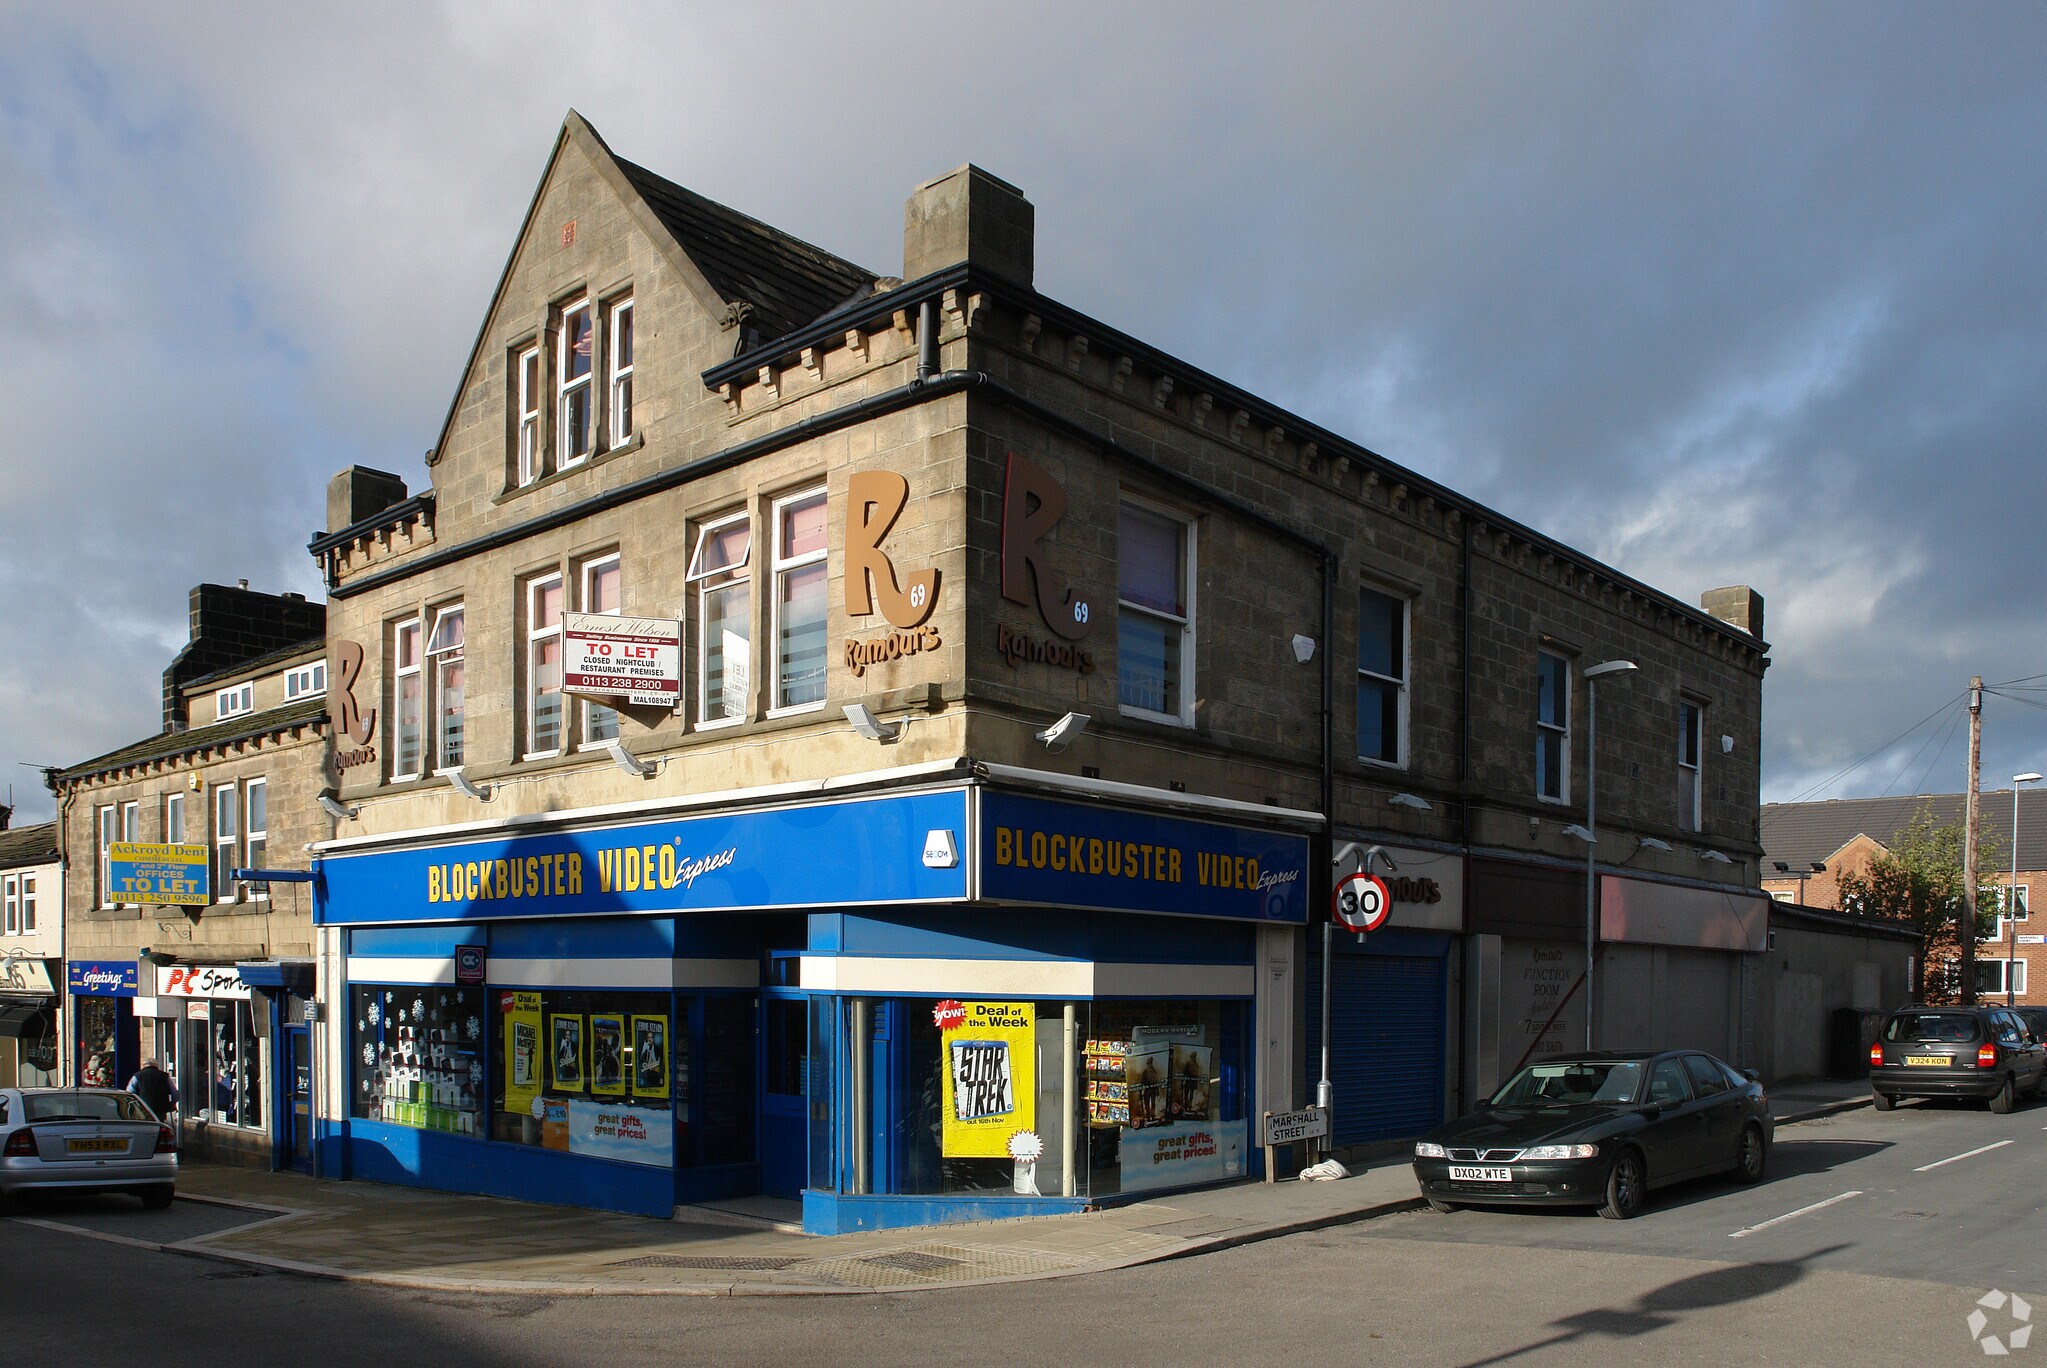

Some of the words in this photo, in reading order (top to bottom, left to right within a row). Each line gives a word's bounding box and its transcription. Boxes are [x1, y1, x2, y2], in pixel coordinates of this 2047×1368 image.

[910, 584, 925, 607] 69
[1074, 601, 1088, 623] 69
[572, 616, 621, 632] Ernest
[625, 619, 671, 636] Wilson
[586, 643, 612, 656] TO
[624, 646, 658, 659] LET
[844, 625, 941, 677] Rumours
[583, 656, 610, 665] CLOSED
[616, 658, 655, 667] NIGHTCLUB
[580, 665, 626, 674] RESTAURANT
[630, 667, 664, 676] PREMISES
[582, 676, 609, 686] 0113
[612, 677, 632, 688] 238
[635, 679, 661, 689] 2900
[633, 696, 671, 704] MAL108947
[362, 717, 369, 732] 69
[113, 844, 169, 857] Ackroyd
[175, 846, 205, 856] Dent
[925, 849, 949, 859] SECOM
[996, 826, 1181, 883] BLOCKBUSTER
[1197, 851, 1259, 890] VIDEO
[136, 869, 184, 878] OFFICES
[428, 852, 582, 903] BLOCKBUSTER
[598, 844, 676, 893] VIDEO
[672, 847, 737, 889] Express
[122, 878, 152, 892] TO
[159, 879, 198, 893] LET
[1256, 869, 1299, 892] Express
[116, 893, 144, 902] 0113
[148, 893, 170, 902] 250
[174, 895, 203, 903] 9596
[1341, 891, 1379, 915] 30
[83, 971, 123, 991] Greetings
[165, 969, 200, 994] PC
[1524, 968, 1571, 981] FUNCTION
[1533, 984, 1560, 996] ROOM
[518, 994, 532, 1002] Deal
[523, 1003, 539, 1012] Week
[933, 1008, 965, 1020] WOW!
[976, 1005, 1008, 1016] Deal
[1011, 1008, 1022, 1016] of
[969, 1019, 986, 1027] the
[989, 1017, 1028, 1027] Week
[1525, 1019, 1532, 1034] 7
[1552, 1023, 1567, 1031] WEEK
[960, 1047, 1005, 1082] STAR
[1931, 1057, 1947, 1065] KON
[966, 1078, 1008, 1118] TREK
[598, 1114, 619, 1124] great
[621, 1115, 643, 1128] gifts,
[1272, 1112, 1319, 1128] MARSHALL
[594, 1125, 616, 1136] great
[617, 1127, 647, 1140] prices!
[1274, 1126, 1306, 1140] STREET
[73, 1140, 100, 1149] YH53
[103, 1141, 122, 1149] RXL
[1158, 1135, 1186, 1151] great
[1189, 1132, 1213, 1147] gifts,
[1153, 1148, 1181, 1164] great
[1183, 1144, 1217, 1161] prices!
[1454, 1167, 1482, 1179] DX02
[1484, 1168, 1507, 1179] WTE
